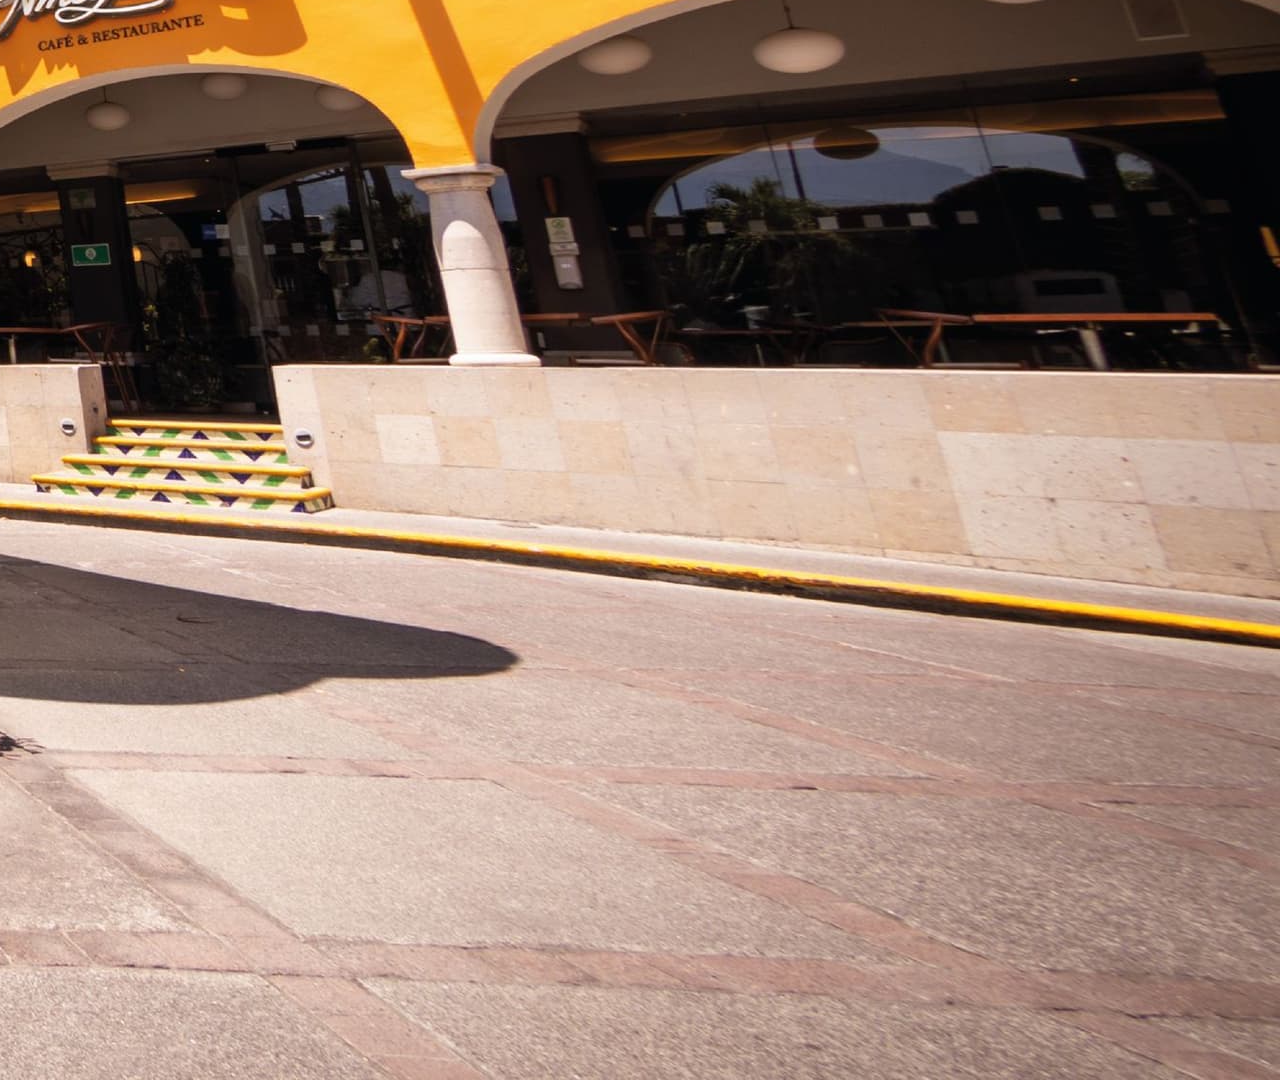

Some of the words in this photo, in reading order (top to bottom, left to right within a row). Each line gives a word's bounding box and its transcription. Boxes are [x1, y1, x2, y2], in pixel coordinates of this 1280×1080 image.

[37, 34, 74, 52] CAFÉ
[77, 34, 89, 46] &
[92, 13, 205, 44] RESTAURANTE
